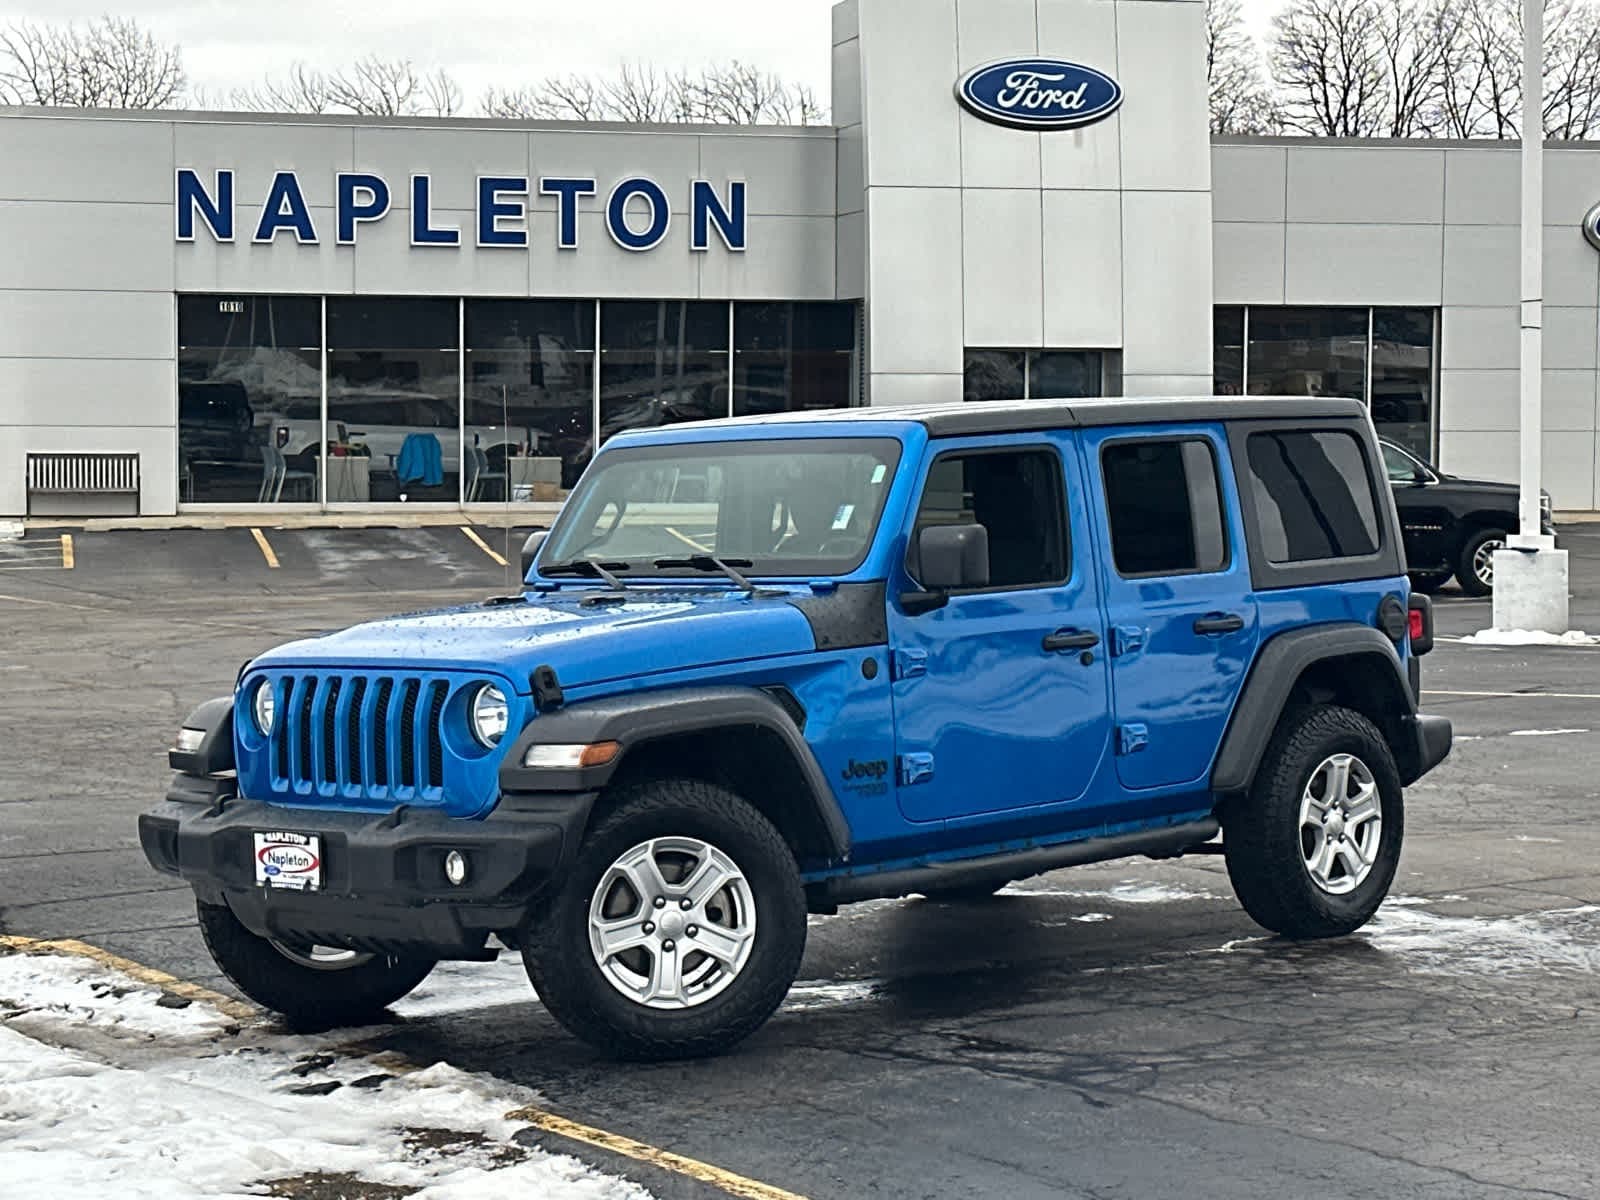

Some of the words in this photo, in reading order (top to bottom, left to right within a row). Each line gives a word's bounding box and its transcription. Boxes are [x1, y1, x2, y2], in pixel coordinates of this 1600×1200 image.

[997, 71, 1088, 109] Ford
[175, 168, 747, 251] NAPLETON
[842, 758, 888, 781] Jeep
[268, 850, 309, 867] Napleton
